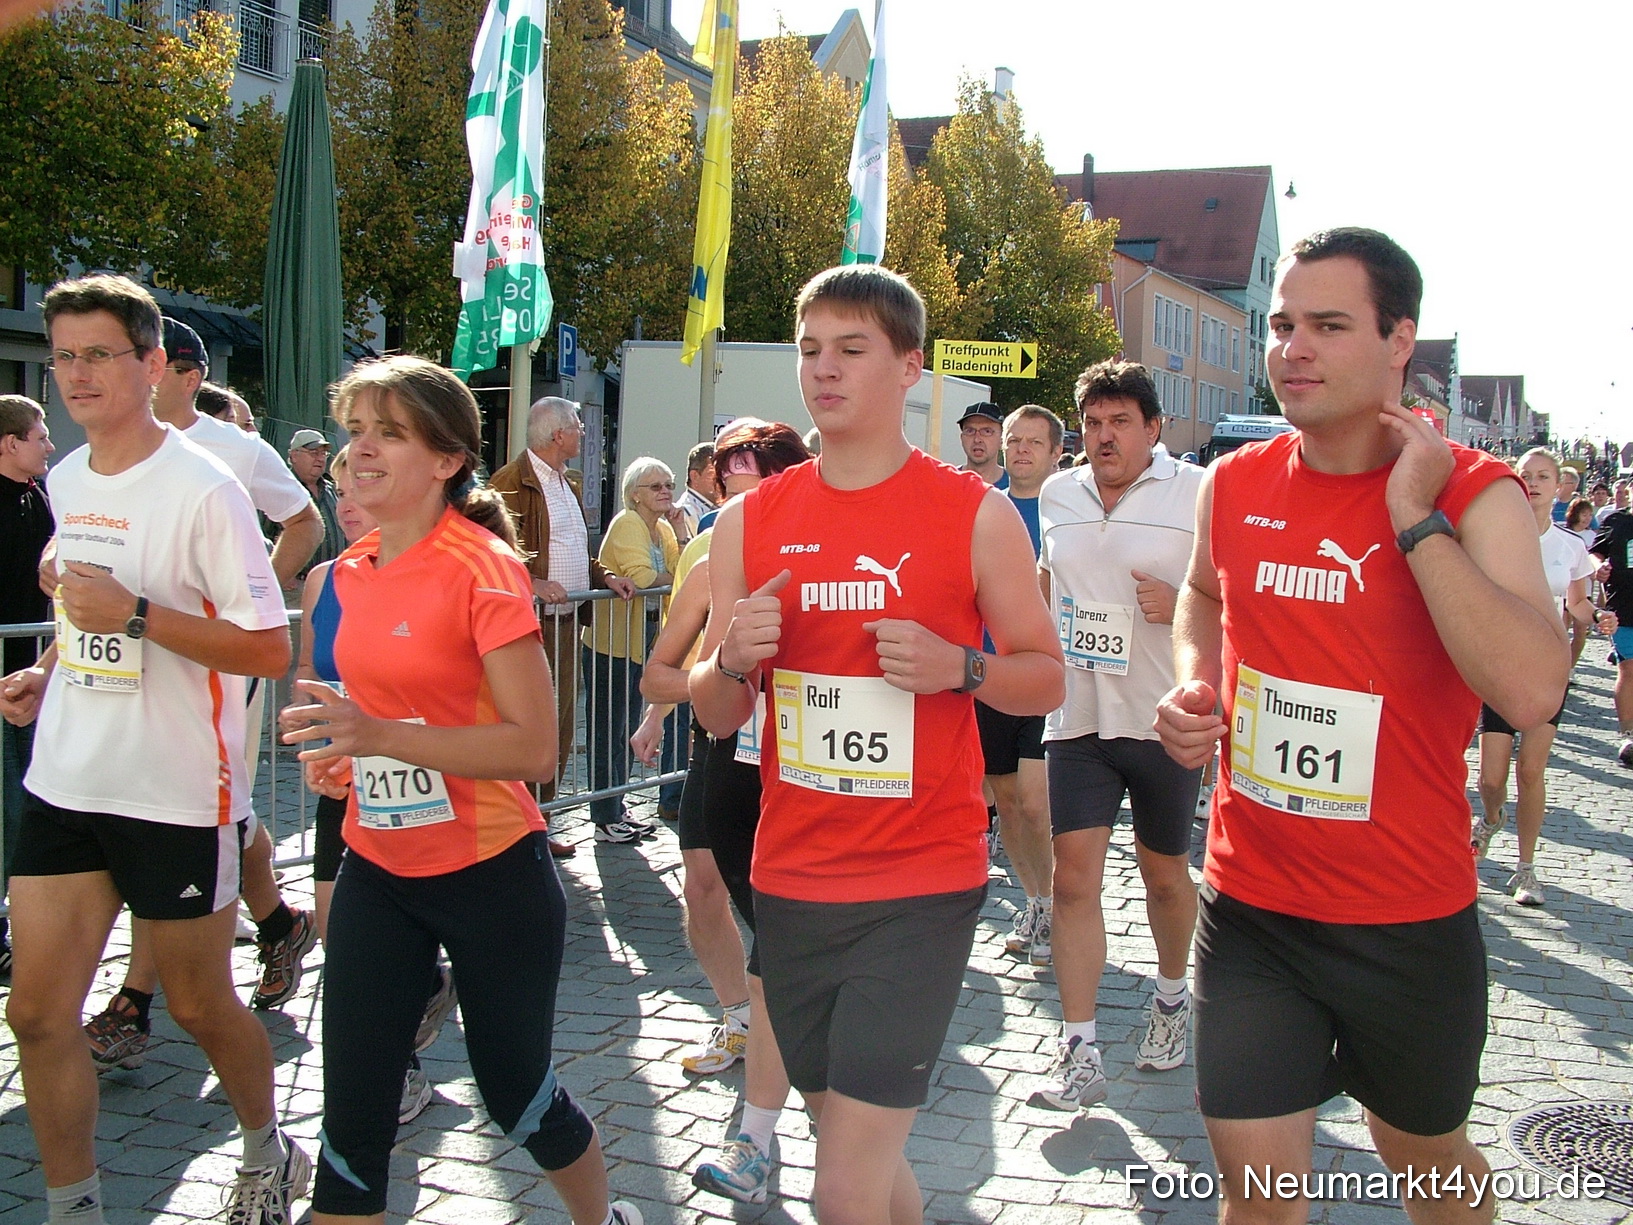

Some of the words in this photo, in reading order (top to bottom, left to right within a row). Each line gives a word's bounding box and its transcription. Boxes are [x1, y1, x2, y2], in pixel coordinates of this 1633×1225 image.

[563, 330, 573, 369] P
[943, 344, 1010, 358] Treffpunkt
[942, 359, 1014, 374] Bladenight
[1232, 425, 1272, 434] BOCK
[586, 407, 595, 508] INDIGO
[63, 513, 131, 530] SportScheck
[1243, 514, 1287, 530] MTB-08
[779, 544, 821, 554] MTB-08
[1255, 560, 1347, 604] PUMA
[801, 580, 885, 612] PUMA
[1075, 605, 1108, 622] Lorenz
[78, 633, 122, 663] 166
[1074, 630, 1124, 655] 2933
[807, 684, 841, 709] Rolf
[1264, 687, 1337, 726] Thomas
[822, 729, 889, 763] 165
[1274, 740, 1342, 783] 161
[366, 768, 433, 799] 2170
[781, 765, 823, 784] BOCK
[854, 779, 910, 790] PFLEIDERER
[1233, 772, 1270, 798] BOCK
[1305, 798, 1367, 812] PFLEIDERER
